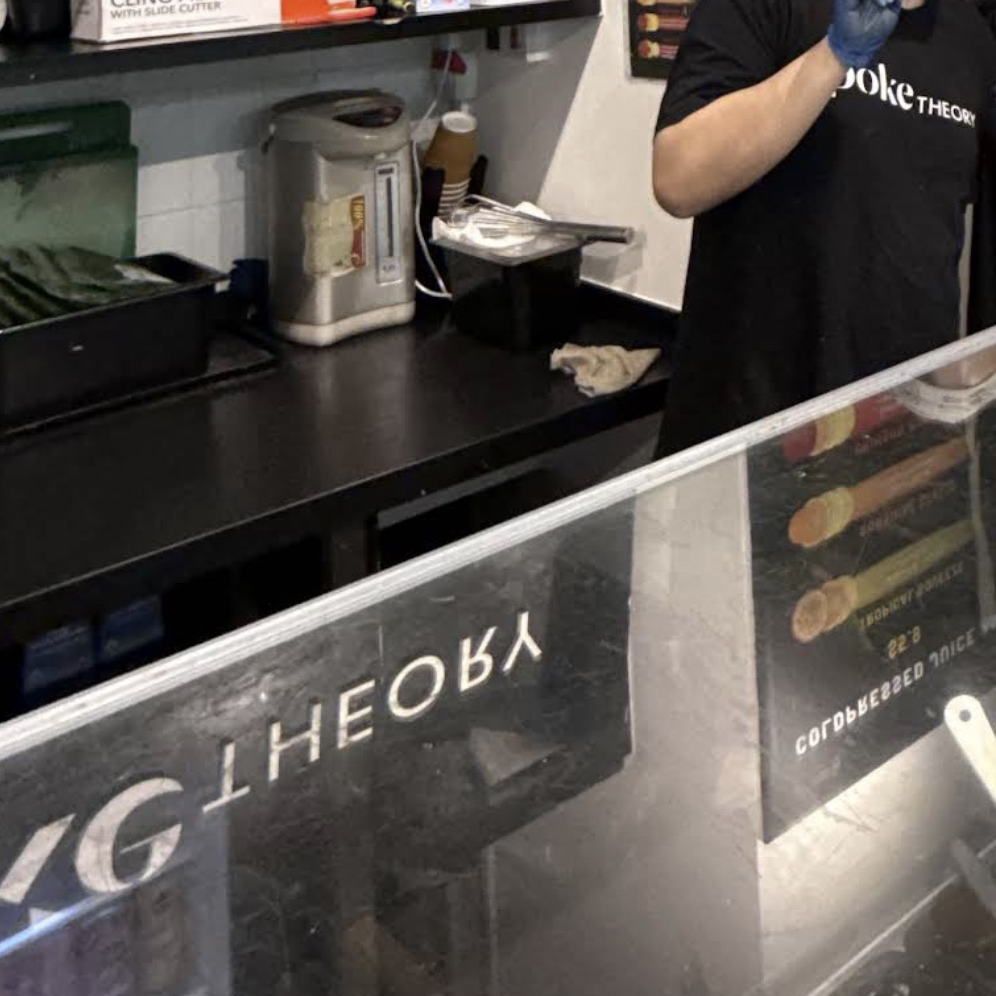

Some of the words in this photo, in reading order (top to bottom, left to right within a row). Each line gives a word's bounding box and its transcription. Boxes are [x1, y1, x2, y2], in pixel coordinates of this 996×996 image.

[110, 8, 143, 19] WITH
[144, 5, 176, 17] SLIDE
[178, 1, 222, 15] CUTTER
[917, 96, 976, 128] THEORY
